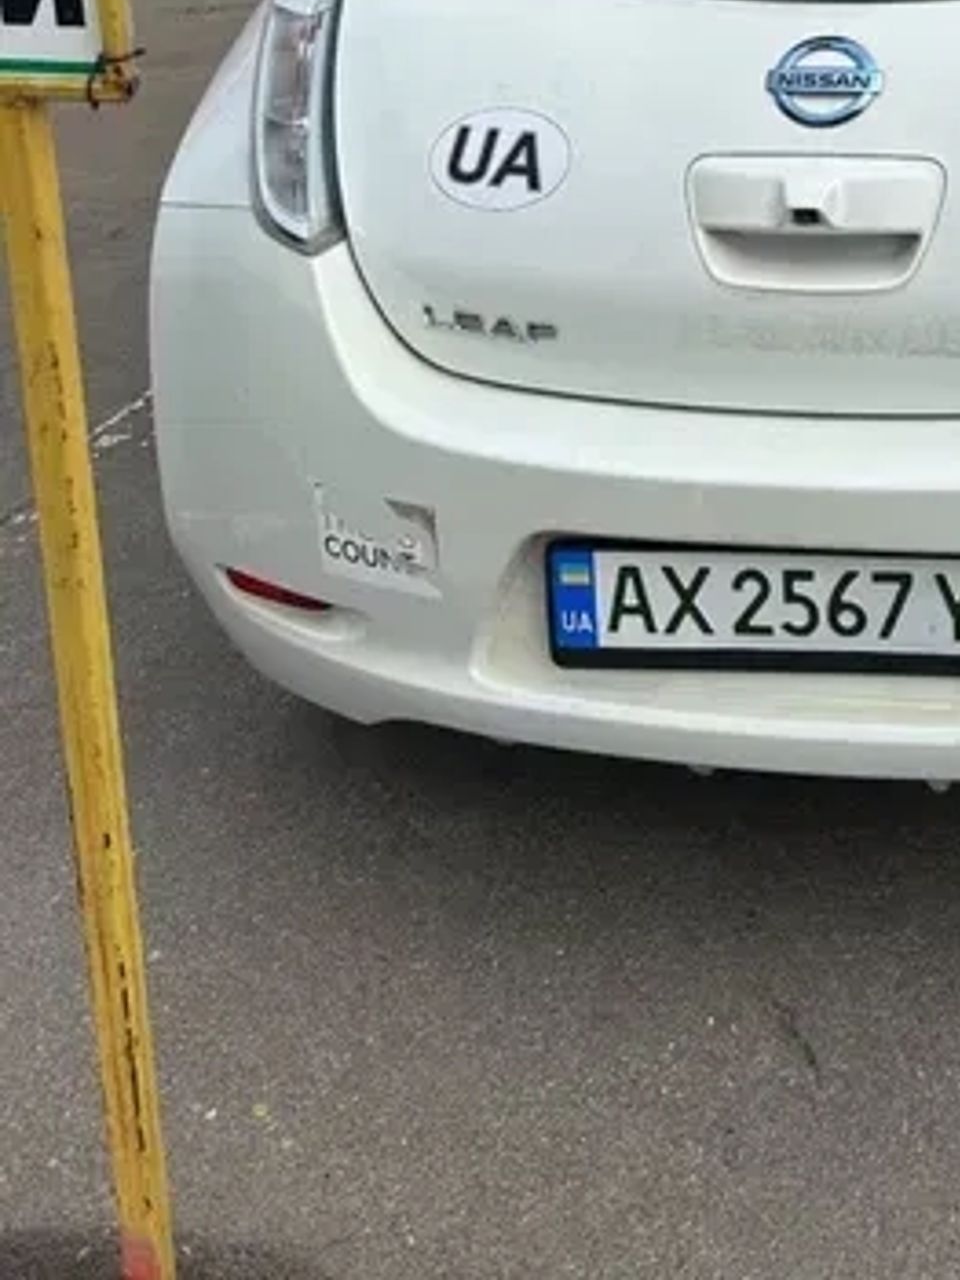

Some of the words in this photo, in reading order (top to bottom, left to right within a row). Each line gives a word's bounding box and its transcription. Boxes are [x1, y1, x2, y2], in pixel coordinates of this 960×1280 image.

[778, 71, 871, 89] NISSAN
[446, 124, 542, 193] UA
[561, 609, 594, 634] UA
[607, 565, 715, 636] AX
[731, 568, 914, 641] 2567
